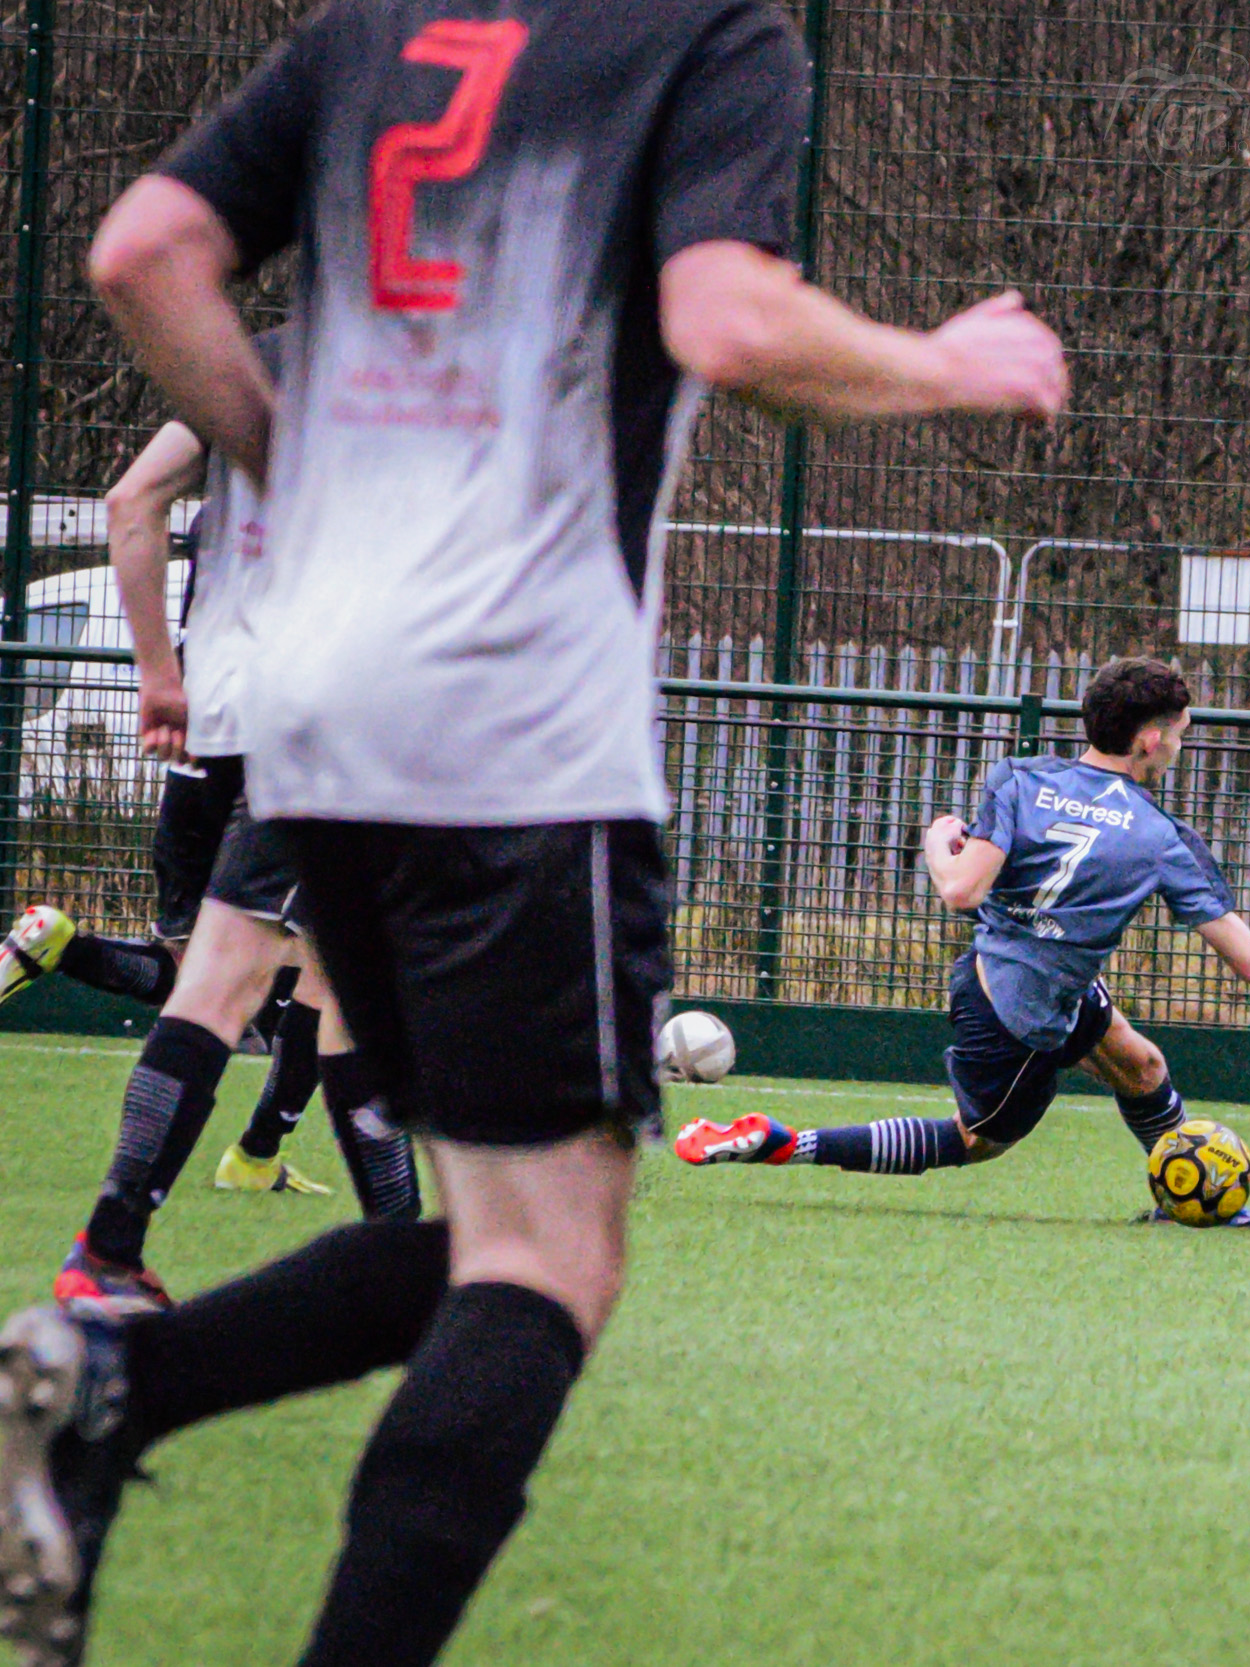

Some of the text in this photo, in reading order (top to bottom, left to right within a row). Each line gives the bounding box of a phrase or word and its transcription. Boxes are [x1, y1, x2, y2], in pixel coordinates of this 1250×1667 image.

[370, 19, 528, 311] 2
[1035, 787, 1134, 830] Everest
[1032, 821, 1101, 910] 7
